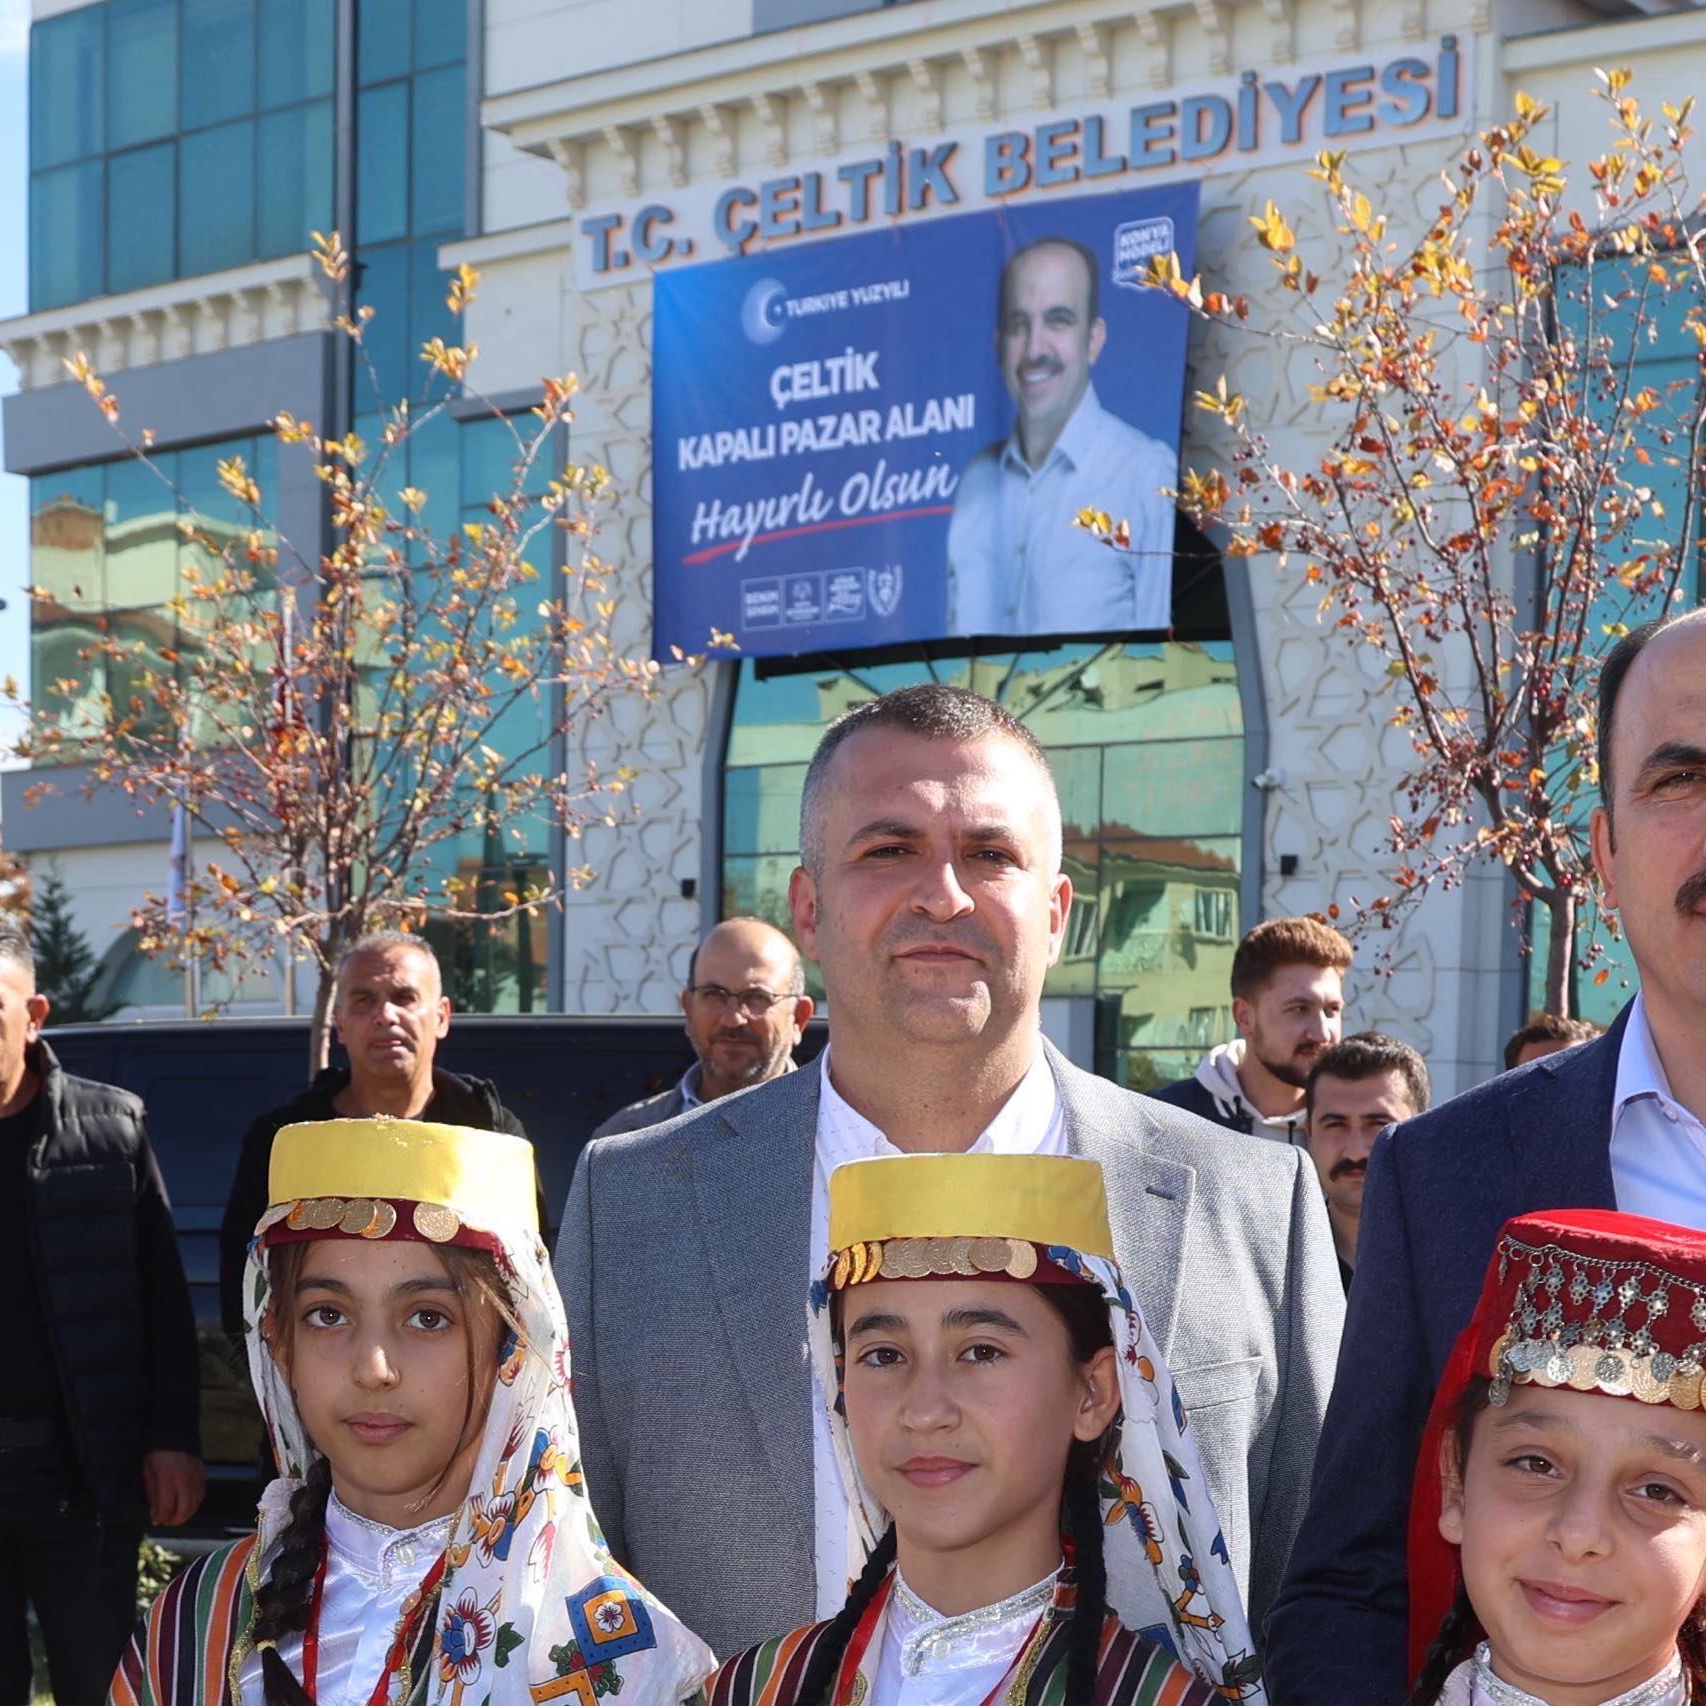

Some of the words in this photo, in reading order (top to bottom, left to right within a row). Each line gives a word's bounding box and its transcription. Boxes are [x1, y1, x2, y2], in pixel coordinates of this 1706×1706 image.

[581, 204, 693, 273] T.C.
[714, 140, 961, 255] ÇELTİK
[984, 34, 1460, 197] BELEDİYESİ
[770, 347, 880, 410] ÇELTİK
[678, 423, 776, 471] KAPALI
[780, 409, 882, 454] PAZAR
[885, 393, 975, 441] ALANI
[691, 471, 834, 562] Hayırlı
[838, 459, 959, 516] Olsun
